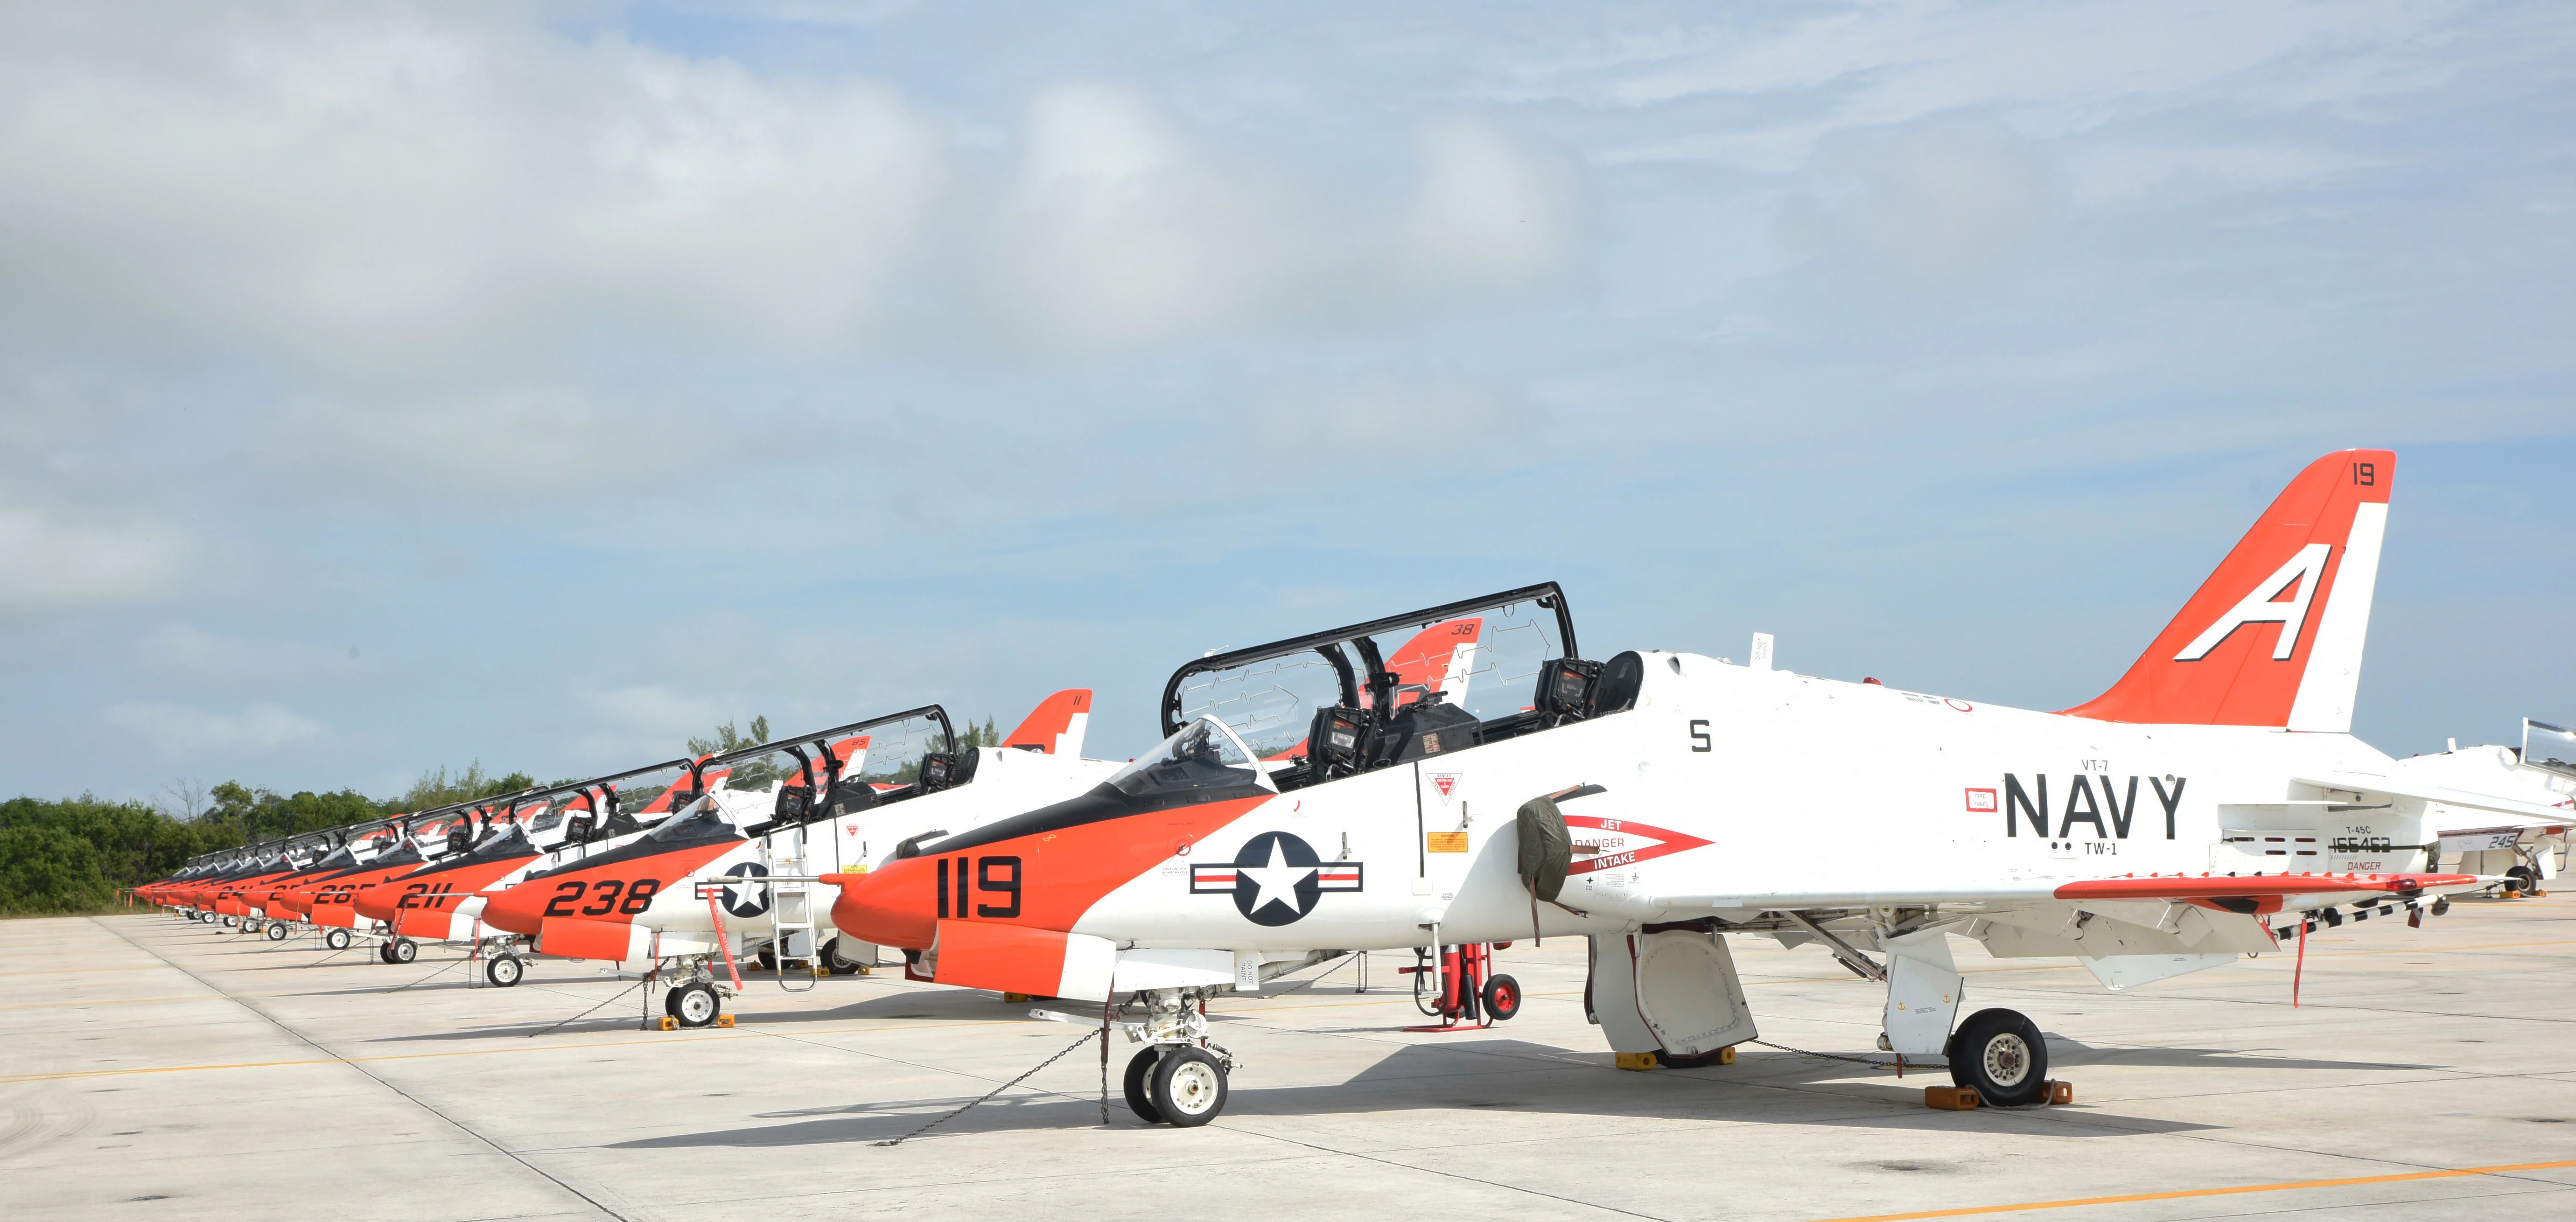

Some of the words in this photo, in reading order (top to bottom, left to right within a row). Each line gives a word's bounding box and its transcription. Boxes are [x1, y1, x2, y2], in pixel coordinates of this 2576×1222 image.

[2353, 462, 2374, 486] 19
[2172, 543, 2333, 662] A
[1451, 624, 1475, 635] 38
[1756, 651, 1761, 660] DO
[1073, 695, 1082, 705] 11
[2081, 759, 2108, 771] VT-7
[2004, 773, 2187, 840] NAVY
[1600, 819, 1622, 831] JET
[2345, 826, 2371, 834] T-45C
[2084, 842, 2117, 855] TW-1
[2488, 835, 2516, 849] 245
[1594, 852, 1636, 869] INTAKE
[2347, 862, 2381, 870] DANGER
[938, 856, 1022, 919] 119
[396, 882, 453, 908] 211
[543, 879, 661, 916] 238
[1247, 960, 1253, 969] DO
